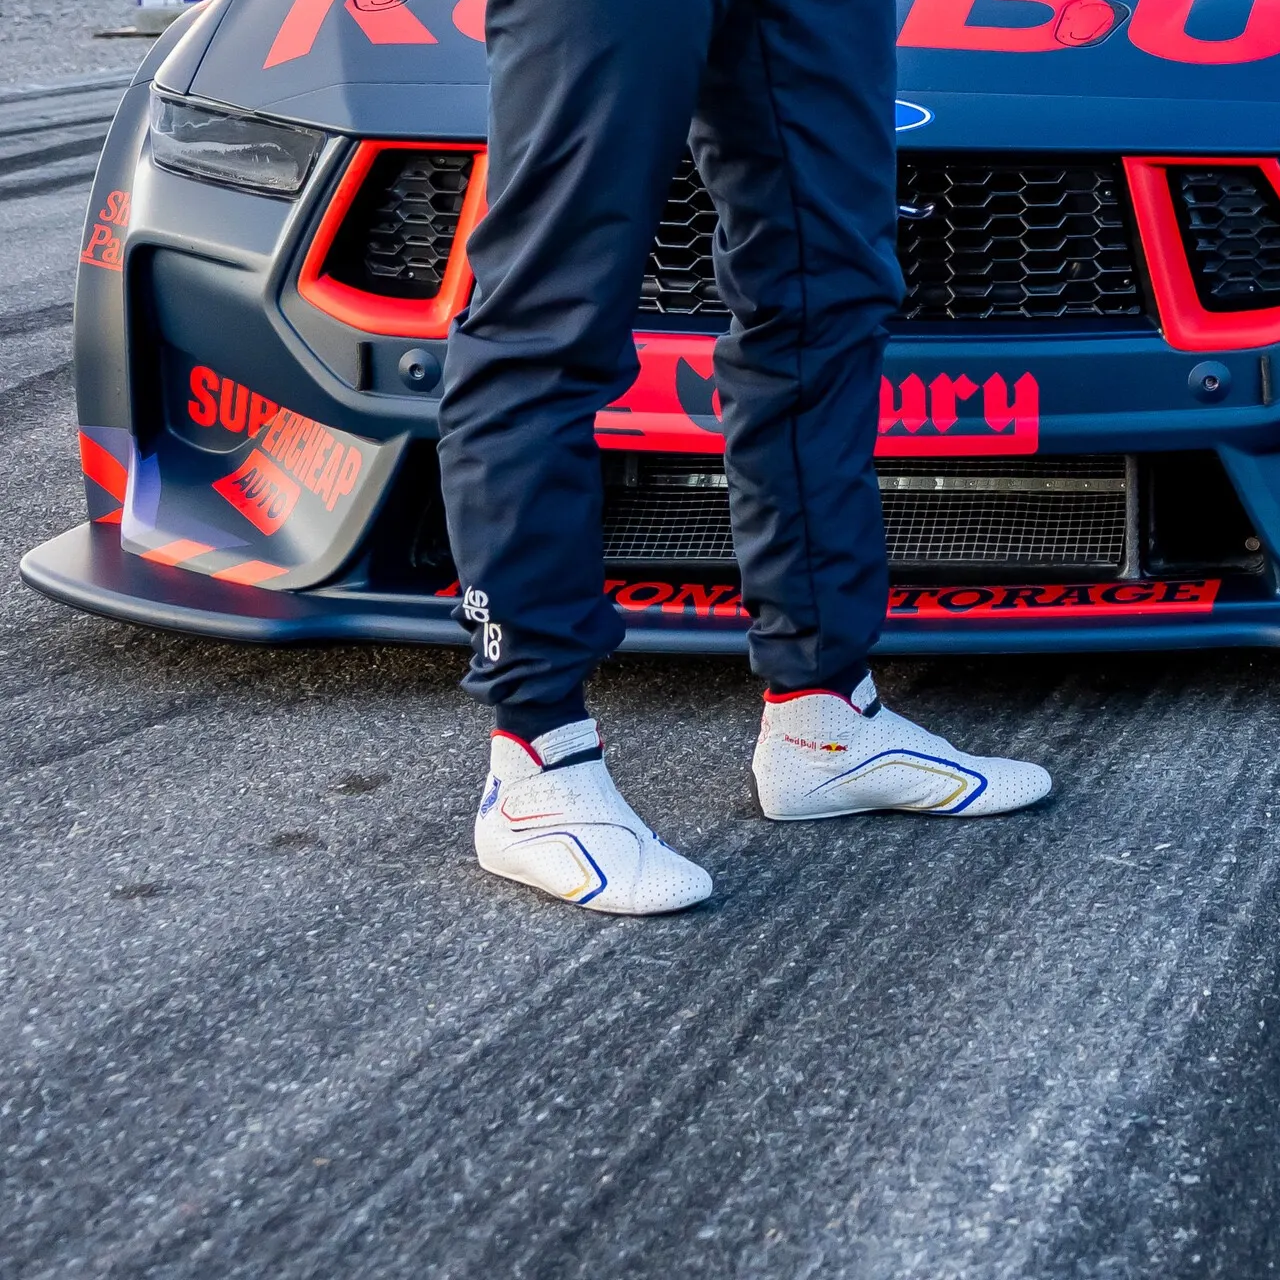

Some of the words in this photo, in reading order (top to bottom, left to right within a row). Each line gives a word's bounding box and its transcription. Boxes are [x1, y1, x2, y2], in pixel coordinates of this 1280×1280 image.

[81, 223, 124, 266] Pa
[188, 365, 362, 512] SUPERCHEAP
[232, 468, 287, 518] AUTO
[463, 585, 502, 662] spco
[784, 734, 799, 745] Red
[800, 739, 817, 750] Bull
